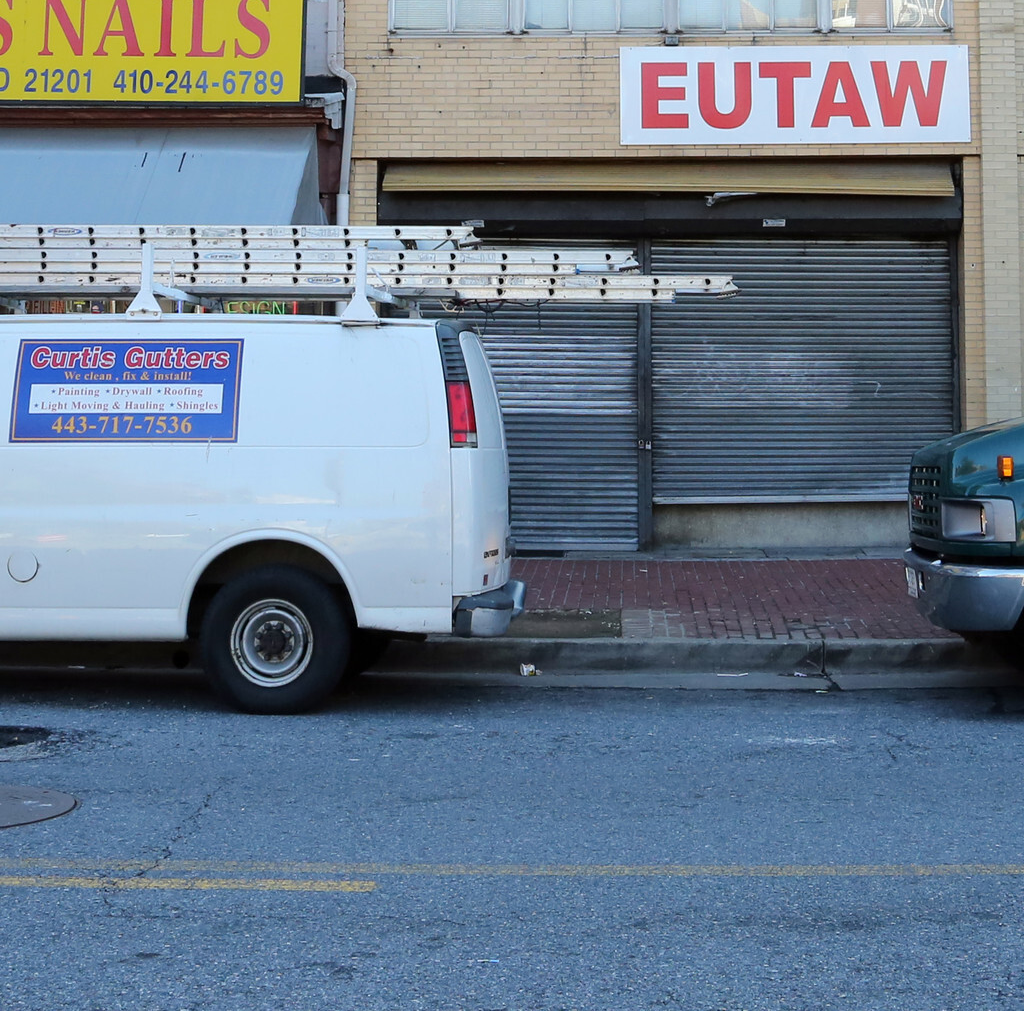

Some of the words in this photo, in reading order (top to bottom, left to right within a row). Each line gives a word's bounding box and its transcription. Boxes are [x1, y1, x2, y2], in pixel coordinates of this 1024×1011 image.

[24, 68, 92, 93] 21201
[113, 69, 285, 95] 410-244-6789
[640, 60, 948, 130] EUTAW
[31, 346, 116, 369] Curtis
[124, 346, 230, 369] Gutters
[64, 371, 81, 381] We
[84, 371, 112, 381] clean
[122, 371, 137, 381] fix
[140, 372, 150, 381] &
[154, 371, 192, 381] install!
[58, 387, 100, 397] Painting
[112, 387, 152, 397] Drywall
[163, 387, 203, 397] Roofing
[41, 401, 68, 411] Light
[71, 401, 109, 411] Moving
[112, 401, 120, 410] &
[124, 401, 165, 411] Hauling
[176, 400, 219, 411] Shingles
[51, 416, 193, 434] 443-717-7536
